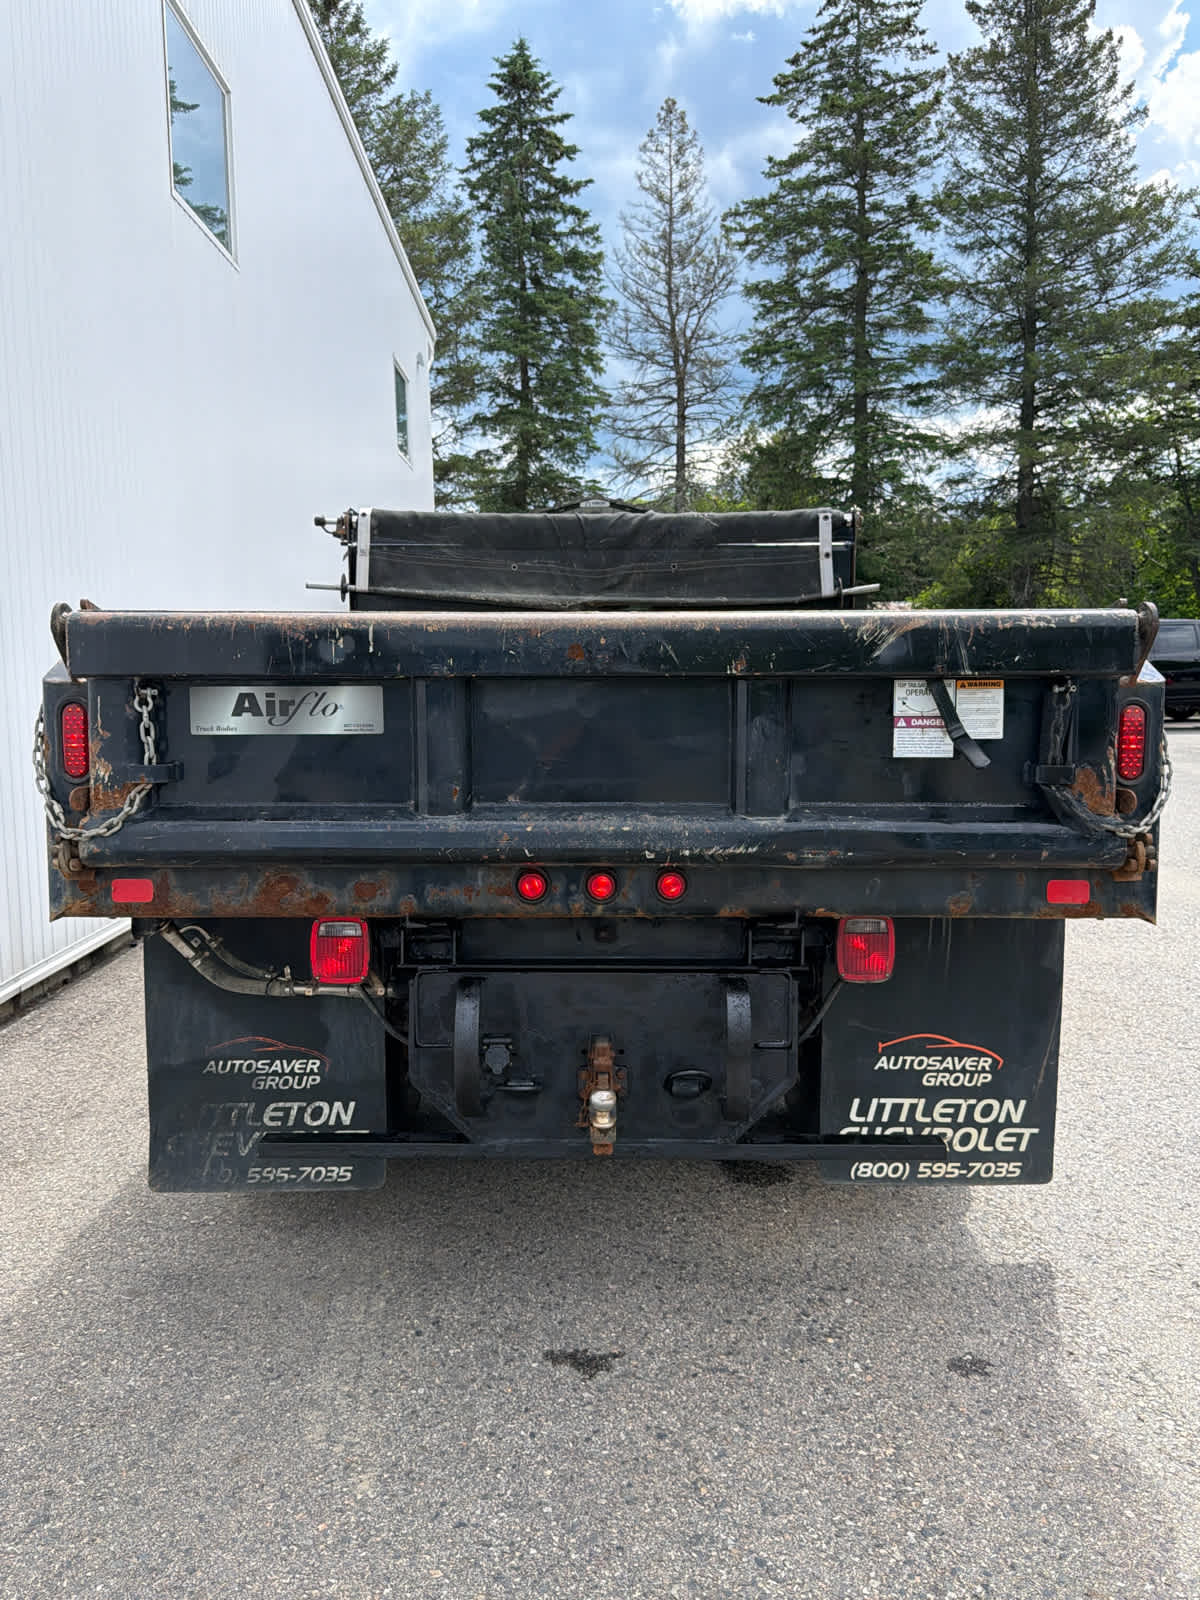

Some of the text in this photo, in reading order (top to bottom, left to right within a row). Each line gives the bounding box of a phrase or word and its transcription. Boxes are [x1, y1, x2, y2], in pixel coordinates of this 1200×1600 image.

[231, 691, 339, 726] Airflo
[911, 718, 945, 727] DANGE
[203, 1060, 321, 1074] AUTOSAVER
[874, 1056, 993, 1071] AUTOSAVER
[252, 1076, 321, 1090] GROUP
[922, 1073, 993, 1087] GROUP
[849, 1098, 1027, 1124] LITTLETON
[247, 1166, 353, 1183] 595-7035
[850, 1162, 1022, 1181] (800) 595-7035
